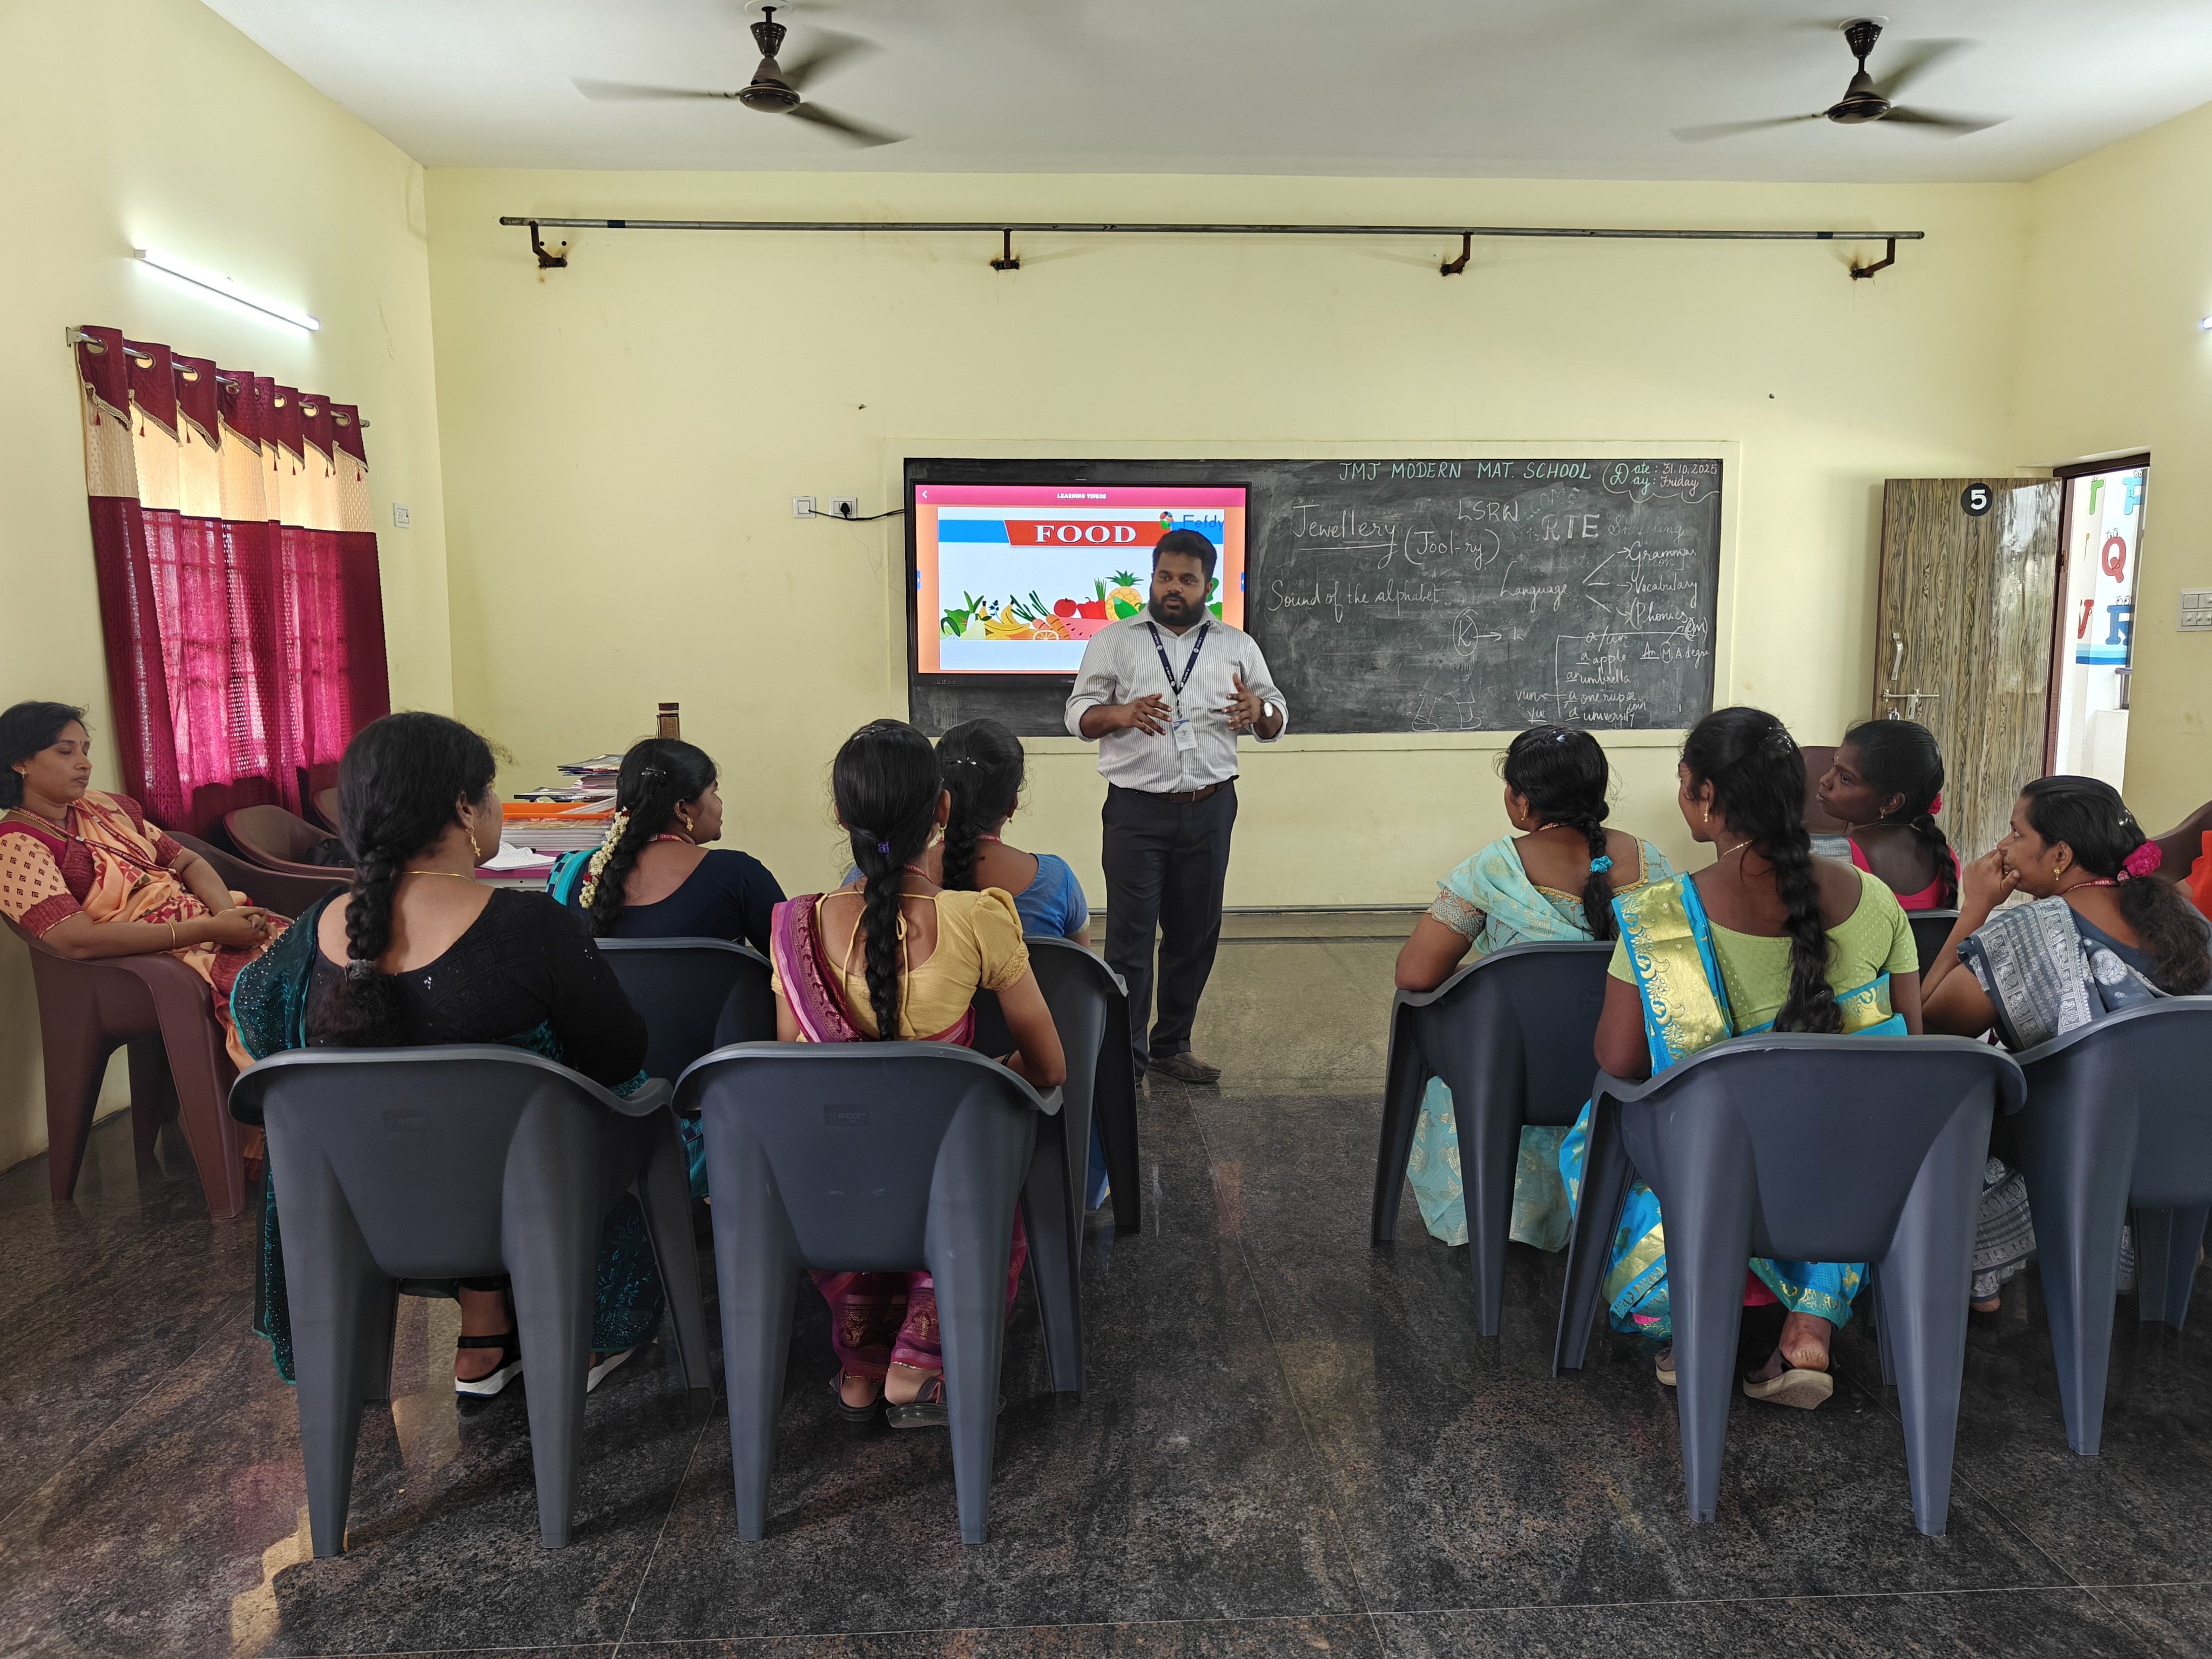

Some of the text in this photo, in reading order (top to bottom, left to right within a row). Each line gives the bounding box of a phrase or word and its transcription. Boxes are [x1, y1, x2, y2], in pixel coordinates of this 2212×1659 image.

[1339, 462, 1591, 480] JMJ MODERN MAT. SCHOOL
[1662, 463, 1718, 475] 31.10.2025
[1660, 475, 1699, 497] Friday
[1971, 489, 1987, 510] 5
[1034, 525, 1137, 543] FOOD
[1292, 504, 1399, 569] Jewellery
[1542, 514, 1600, 541] RTE
[2102, 536, 2126, 583] Q
[1500, 561, 1569, 613] Language
[1635, 572, 1697, 609] Vocabulary
[1267, 578, 1442, 623] Sound of the alphabet
[1581, 651, 1628, 675] a apple
[1581, 666, 1631, 685] umbrella
[1569, 691, 1579, 701] a
[1569, 706, 1635, 729] a university
